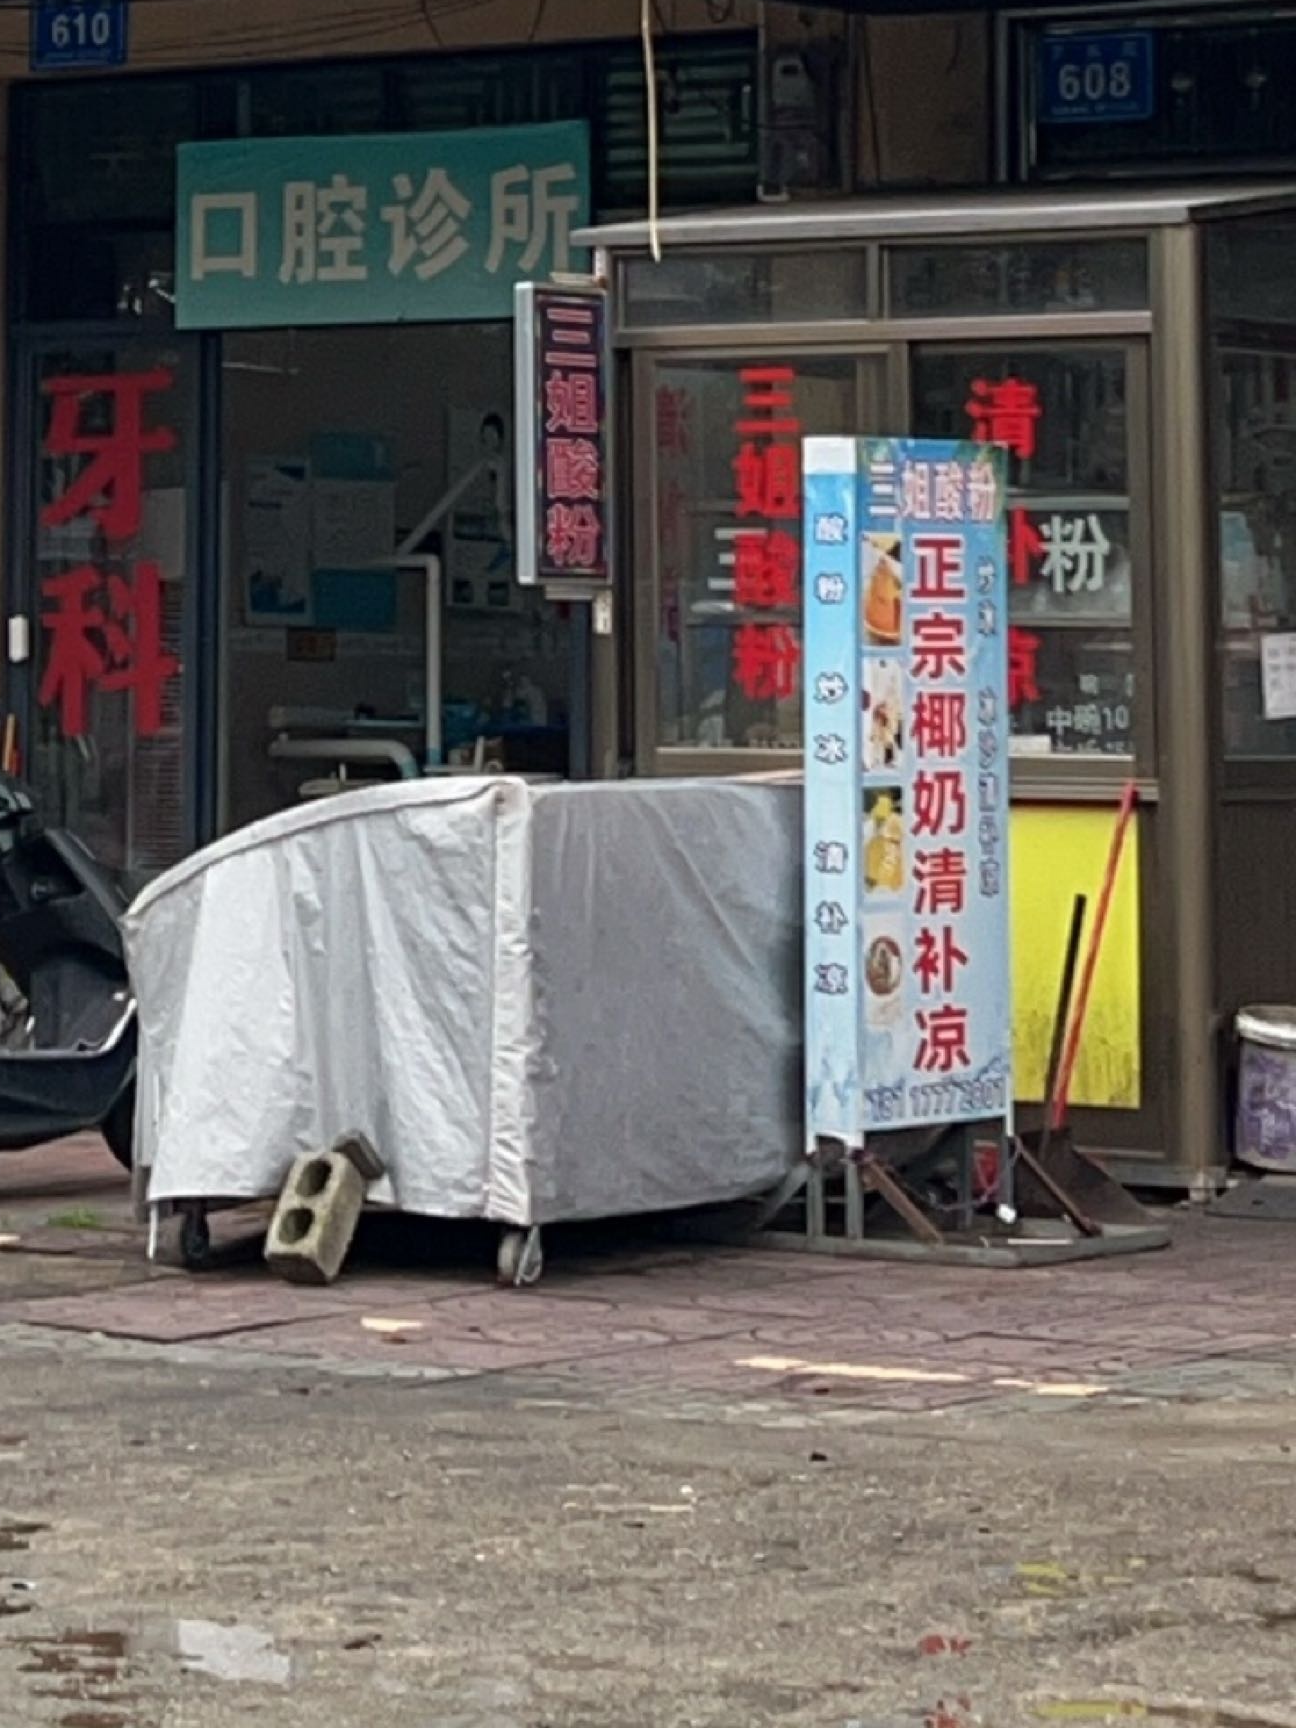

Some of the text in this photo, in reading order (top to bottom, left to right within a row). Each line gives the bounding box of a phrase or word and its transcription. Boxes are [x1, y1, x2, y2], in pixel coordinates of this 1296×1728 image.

[51, 12, 110, 47] 610
[1058, 60, 1131, 101] 608
[190, 163, 579, 285] 口腔诊所
[545, 306, 600, 567] 三姐酸粉
[868, 460, 997, 521] 三姐酸粉
[40, 368, 180, 734] 牙科
[909, 536, 970, 1072] 正宗椰奶清补凉
